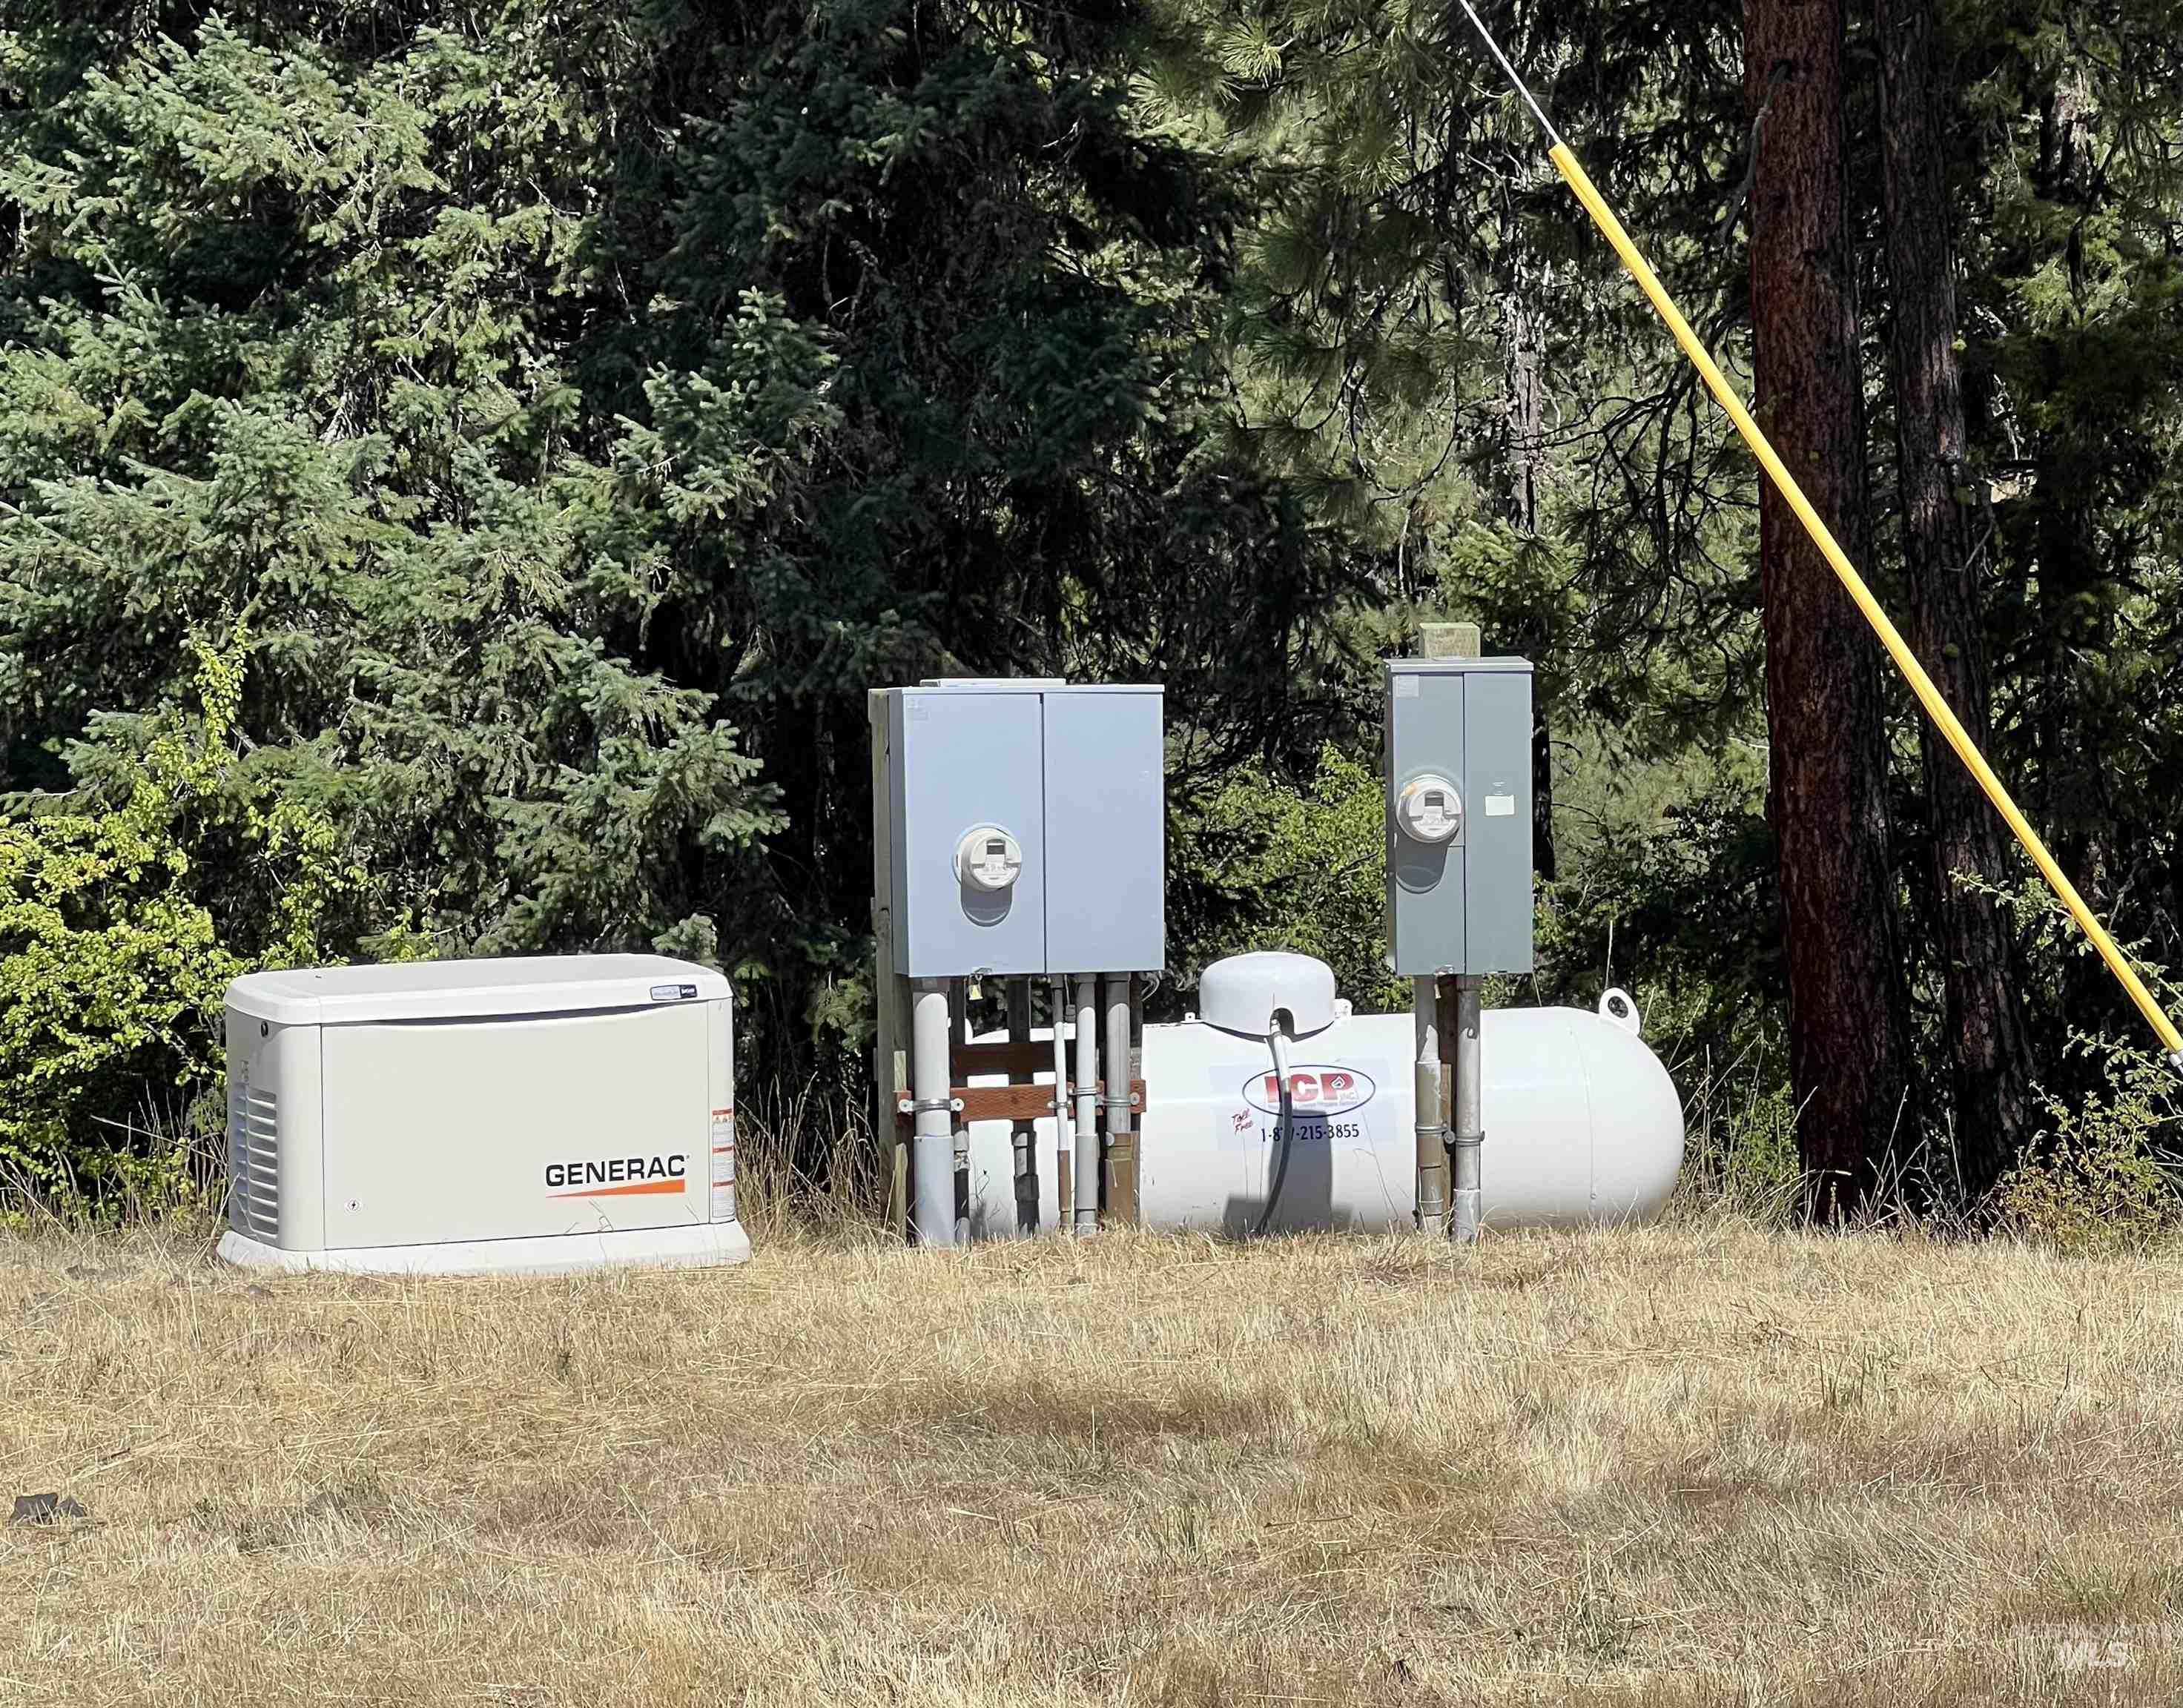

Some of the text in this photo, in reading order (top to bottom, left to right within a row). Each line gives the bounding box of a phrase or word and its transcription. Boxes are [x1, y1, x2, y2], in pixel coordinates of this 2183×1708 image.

[1264, 1073, 1355, 1103] ICP
[1261, 1123, 1360, 1142] 1-8-215-3855
[546, 1154, 685, 1187] GENERAC
